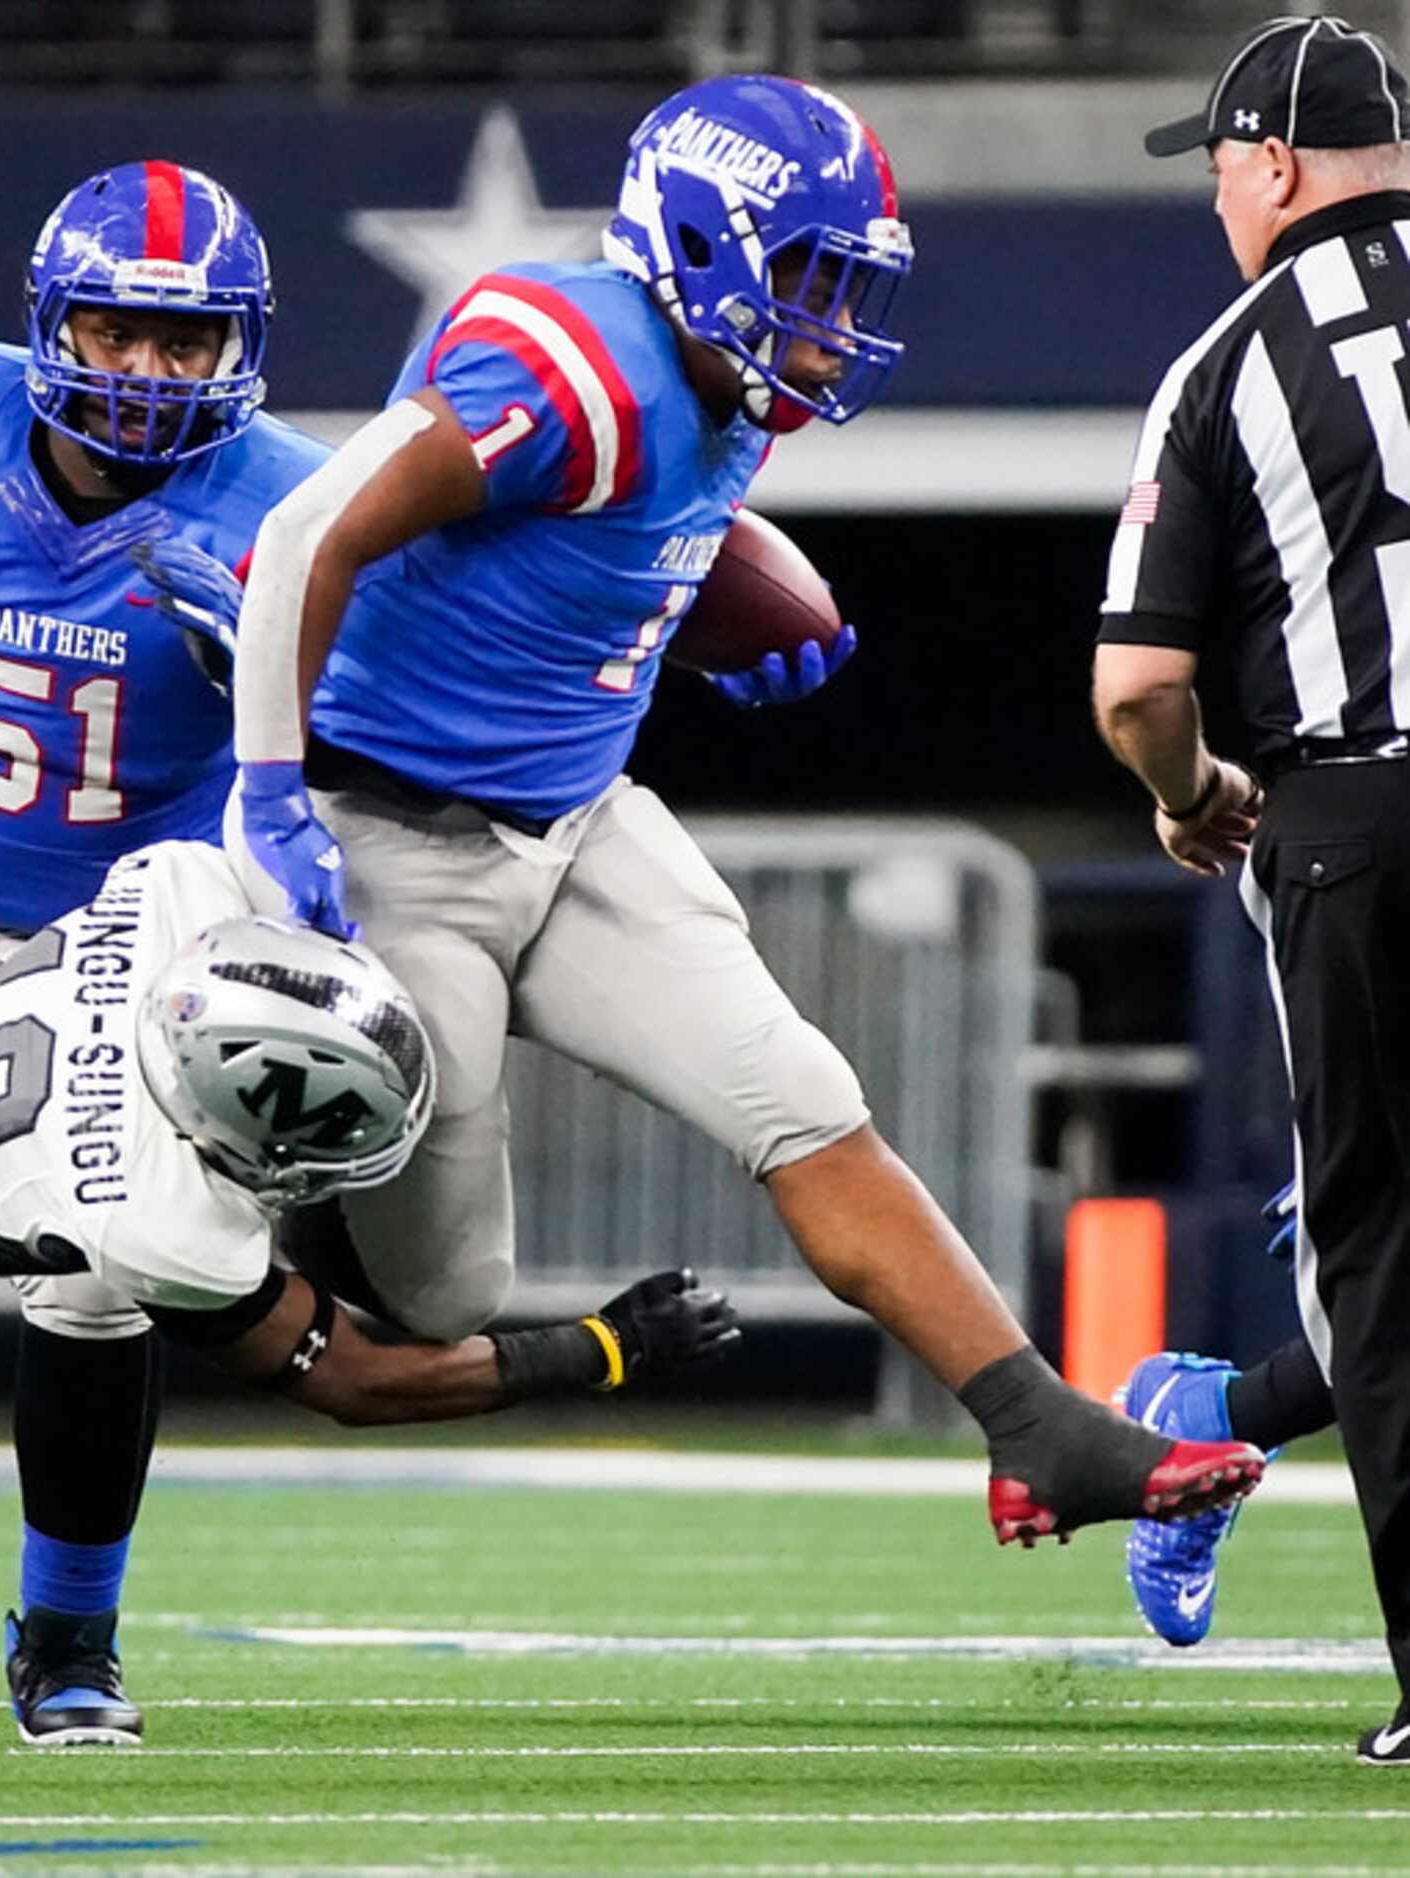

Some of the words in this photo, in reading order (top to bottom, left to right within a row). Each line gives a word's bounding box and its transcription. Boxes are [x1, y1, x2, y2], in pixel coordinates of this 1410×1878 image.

[664, 106, 802, 198] PANTHERS
[466, 402, 538, 472] 1
[592, 582, 690, 692] 1
[236, 1057, 377, 1148] M
